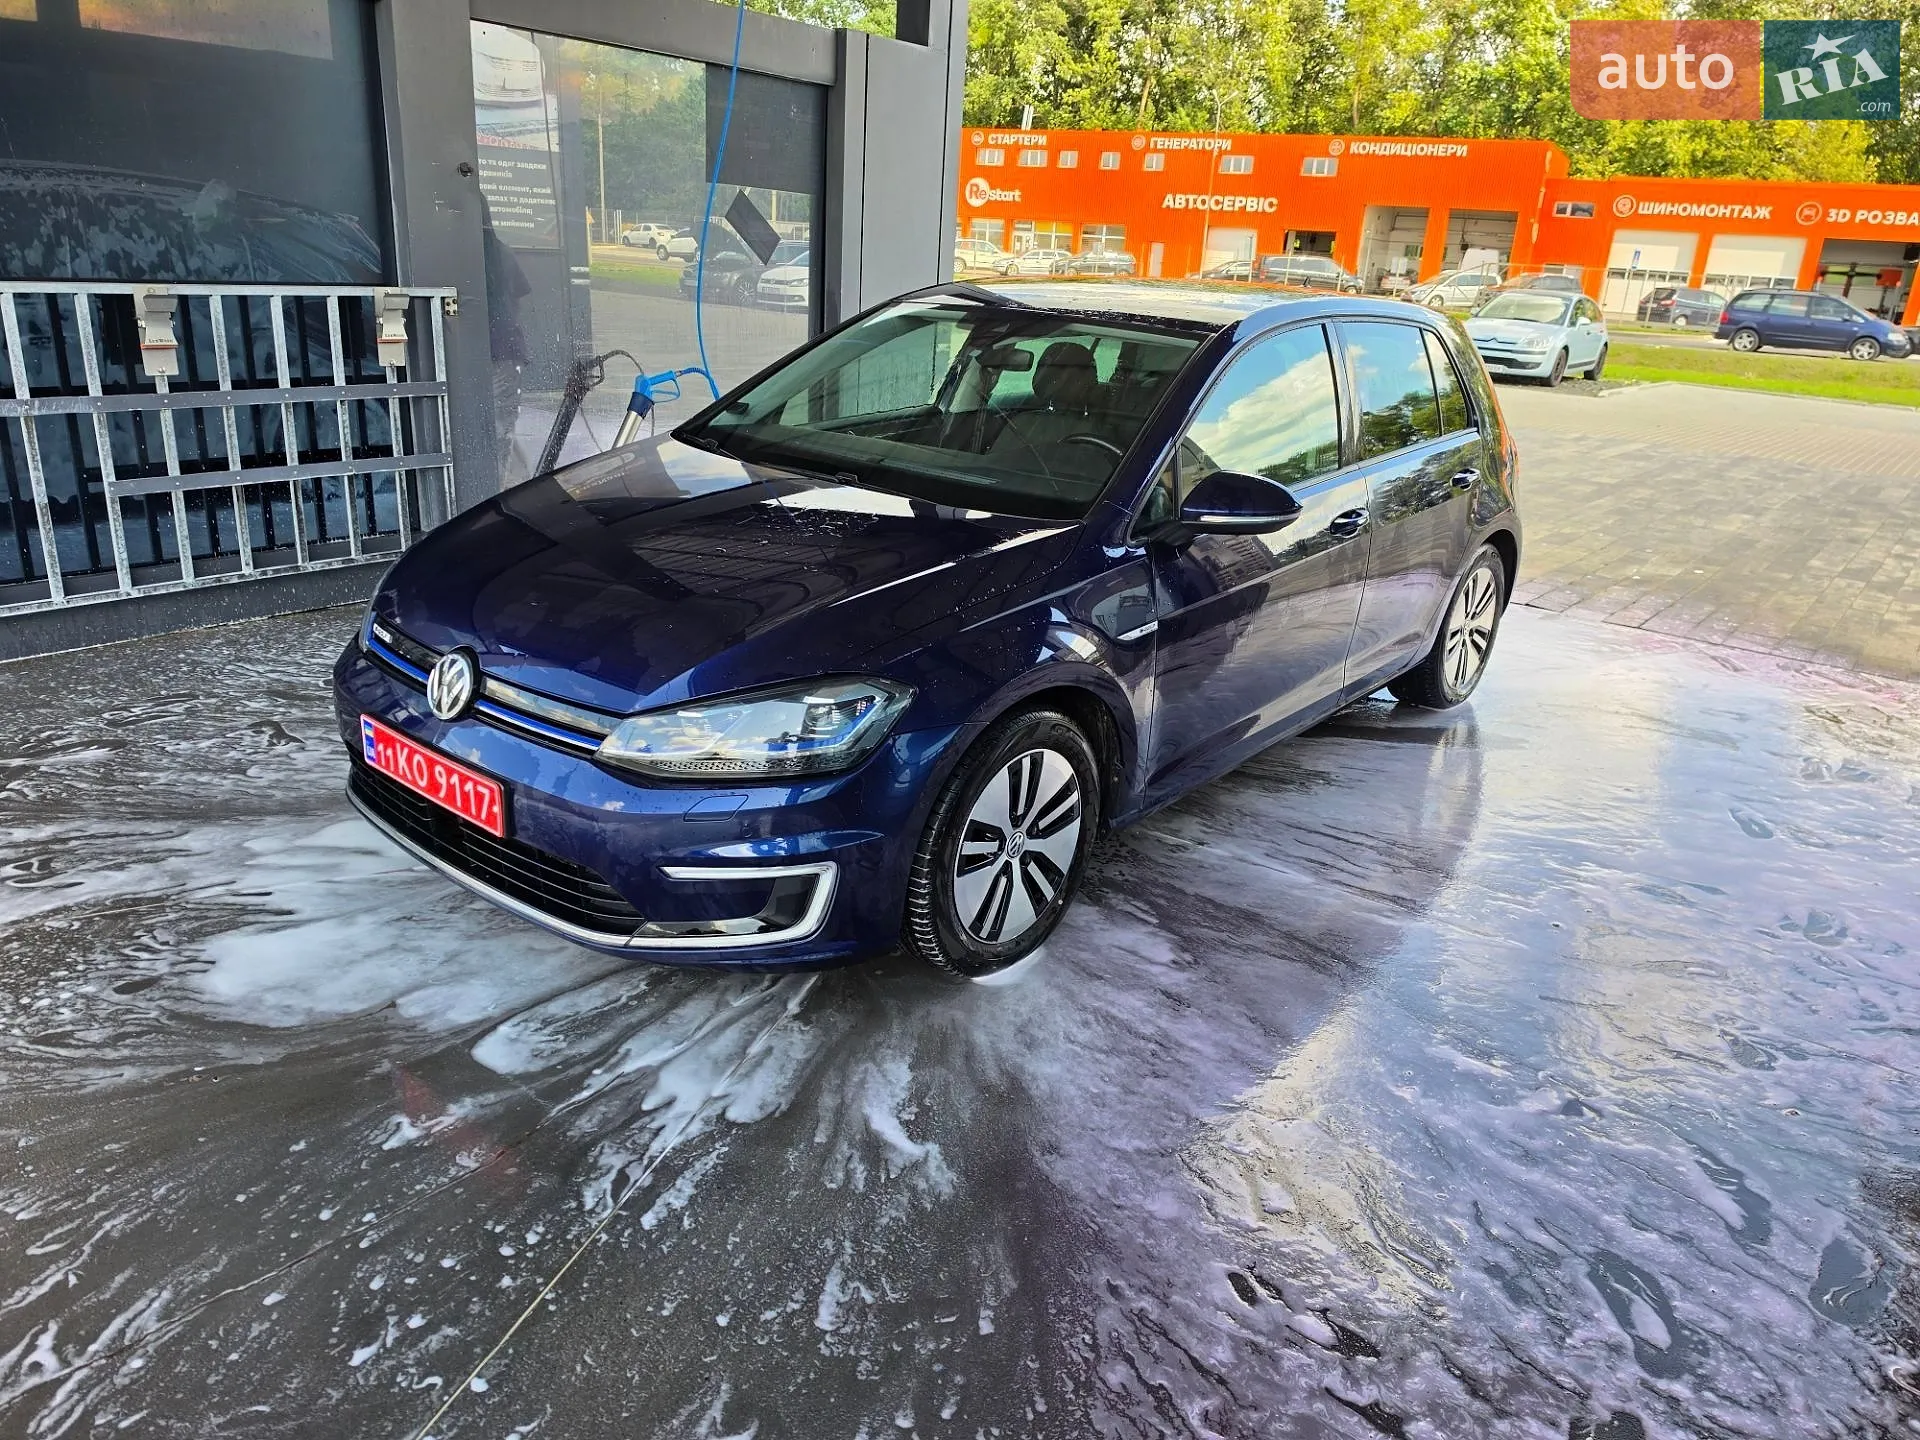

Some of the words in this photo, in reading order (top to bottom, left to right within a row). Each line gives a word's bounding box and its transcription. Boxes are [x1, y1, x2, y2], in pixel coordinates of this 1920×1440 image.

[988, 133, 1047, 146] СТАРТЕРИ
[1150, 137, 1232, 151] ГЕНЕРАТОРИ
[1350, 141, 1468, 157] КОНДИЦІОНЕРИ
[968, 182, 1022, 203] Restart
[1162, 193, 1278, 213] АВТОСЕРВІС
[1638, 201, 1773, 220] ШИНОМОНТАЖ
[1827, 208, 1851, 223] 3D
[434, 767, 491, 822] 9117
